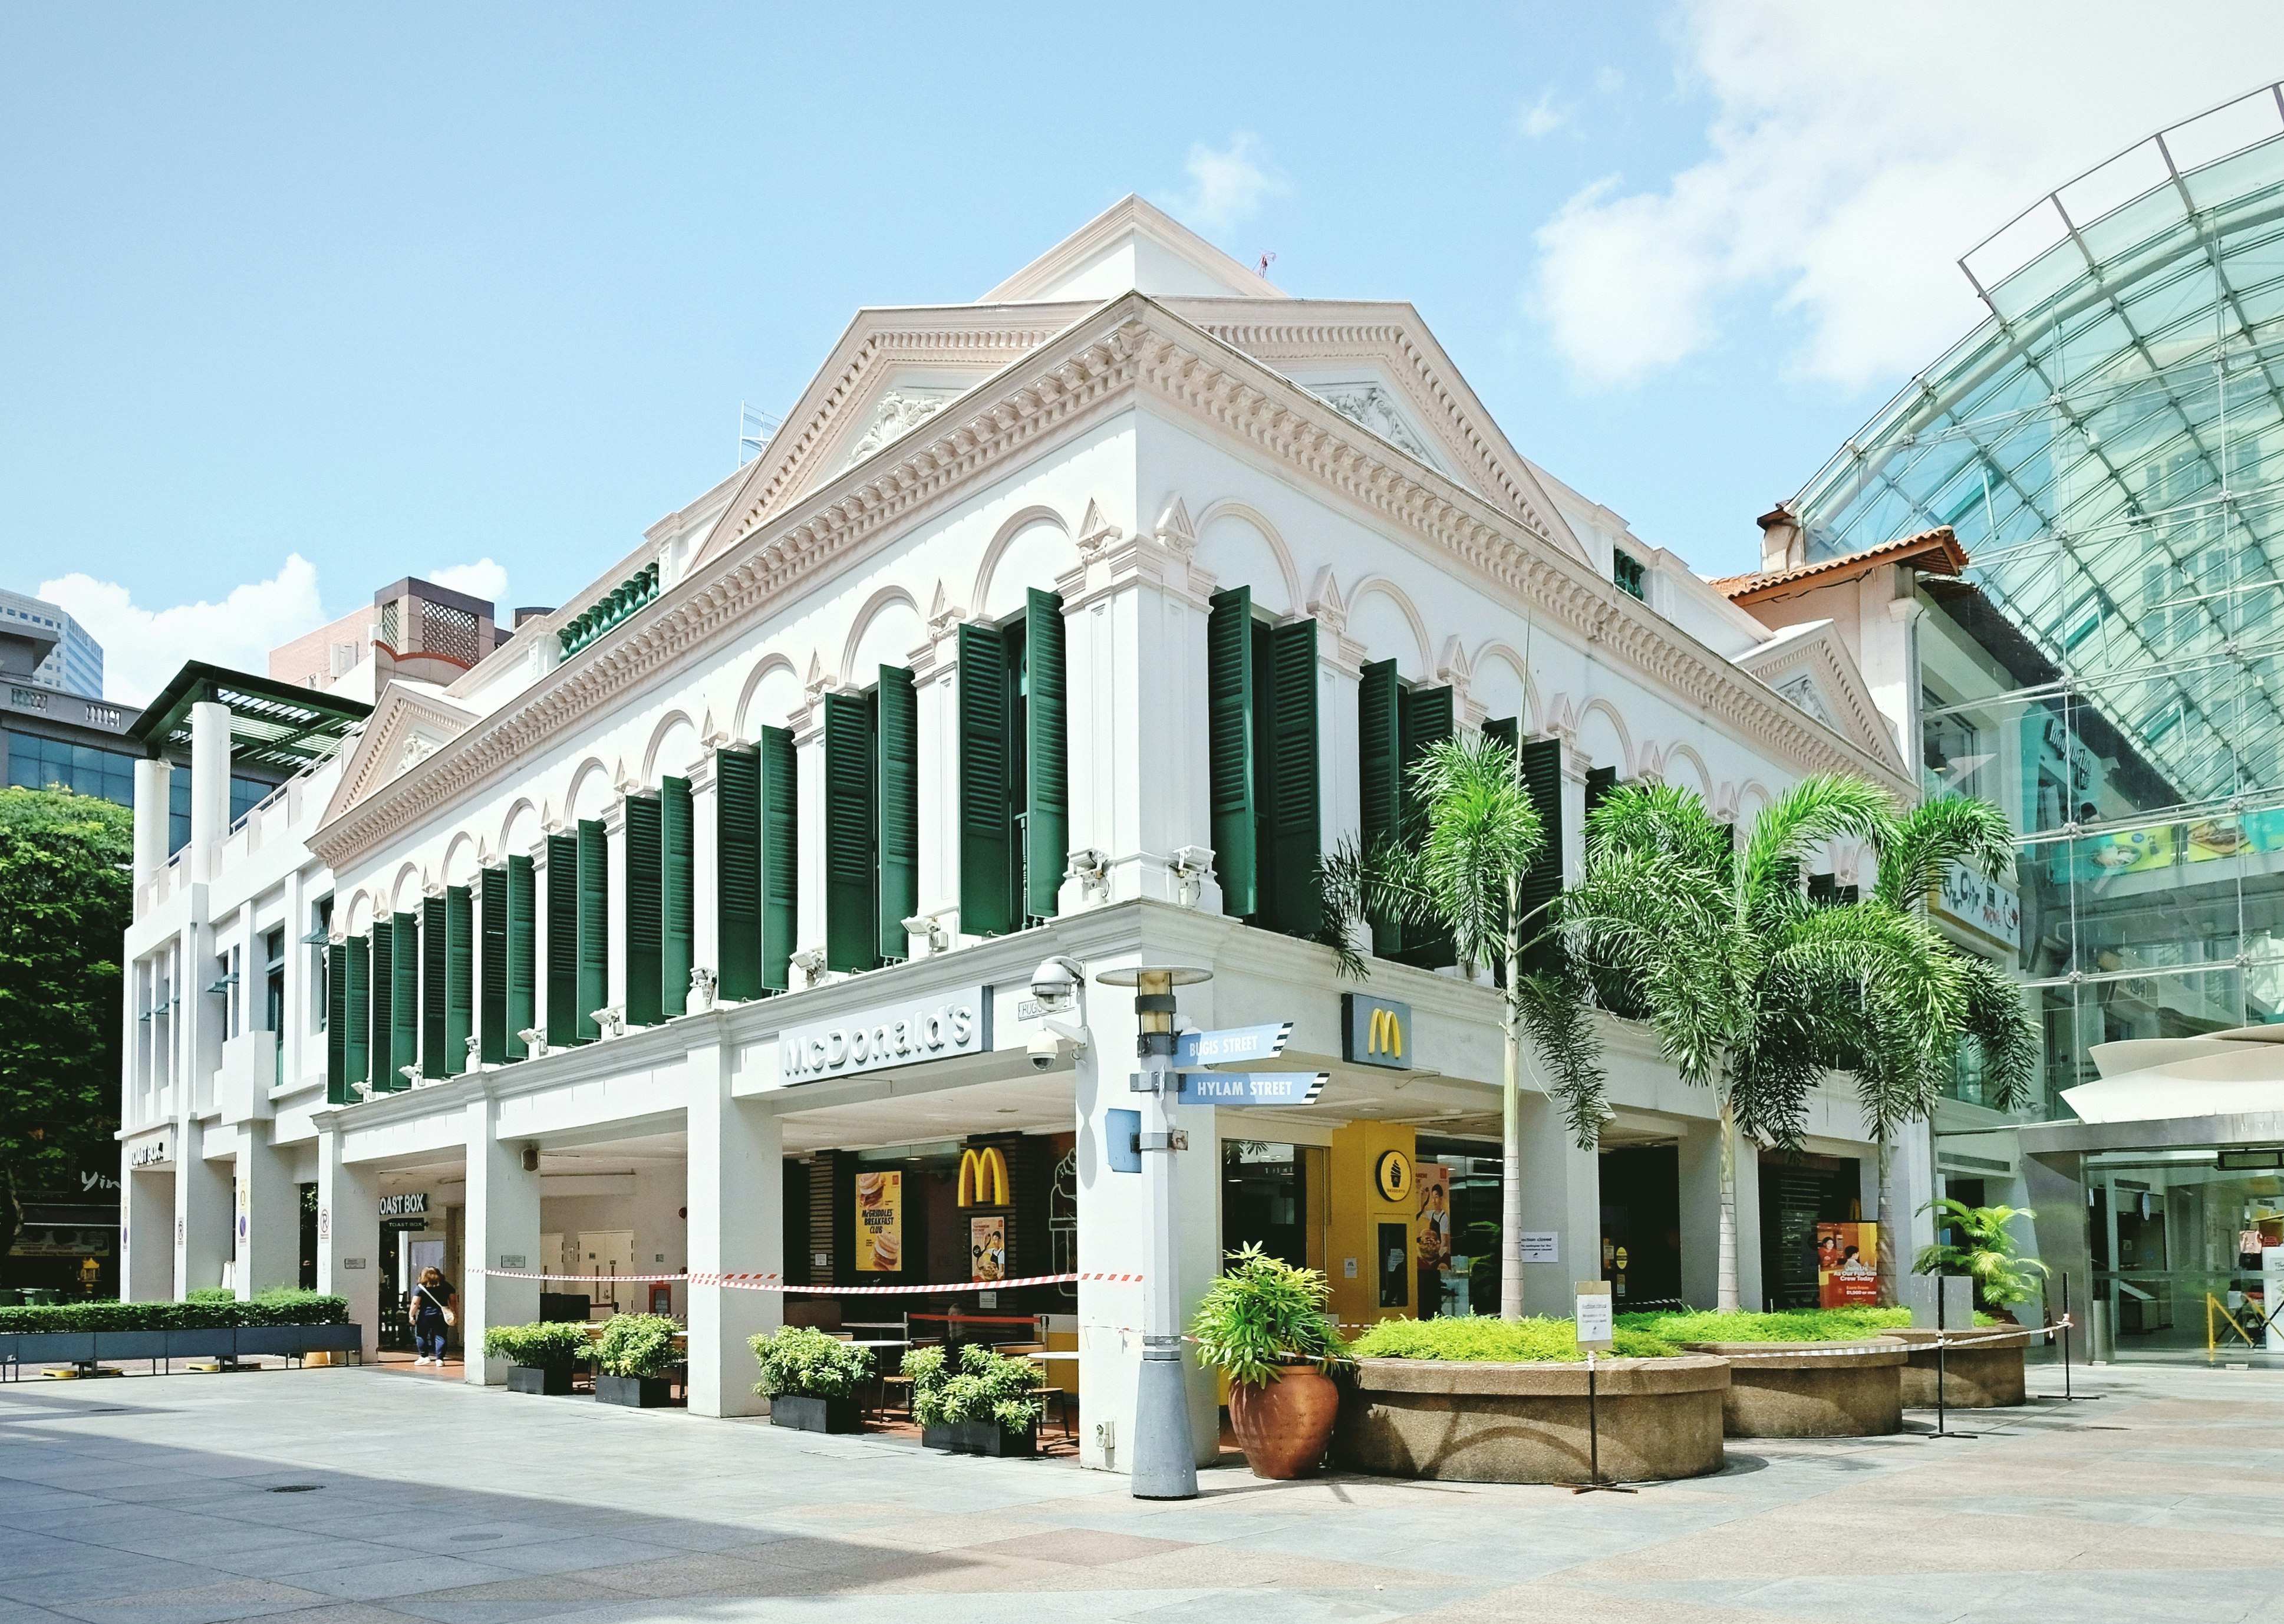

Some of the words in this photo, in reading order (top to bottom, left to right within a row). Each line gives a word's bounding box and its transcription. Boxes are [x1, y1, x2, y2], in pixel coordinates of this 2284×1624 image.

[785, 1003, 973, 1078] McDonald's
[1189, 1040, 1219, 1057] BUGIS
[1222, 1036, 1258, 1053] STREET
[1197, 1082, 1244, 1096] HYLAM
[1249, 1081, 1293, 1096] STREET
[404, 1194, 424, 1213] BOX
[862, 1208, 893, 1218] McGRIDDLES
[865, 1217, 894, 1226] BREAKFAST
[870, 1226, 883, 1234] CLUB
